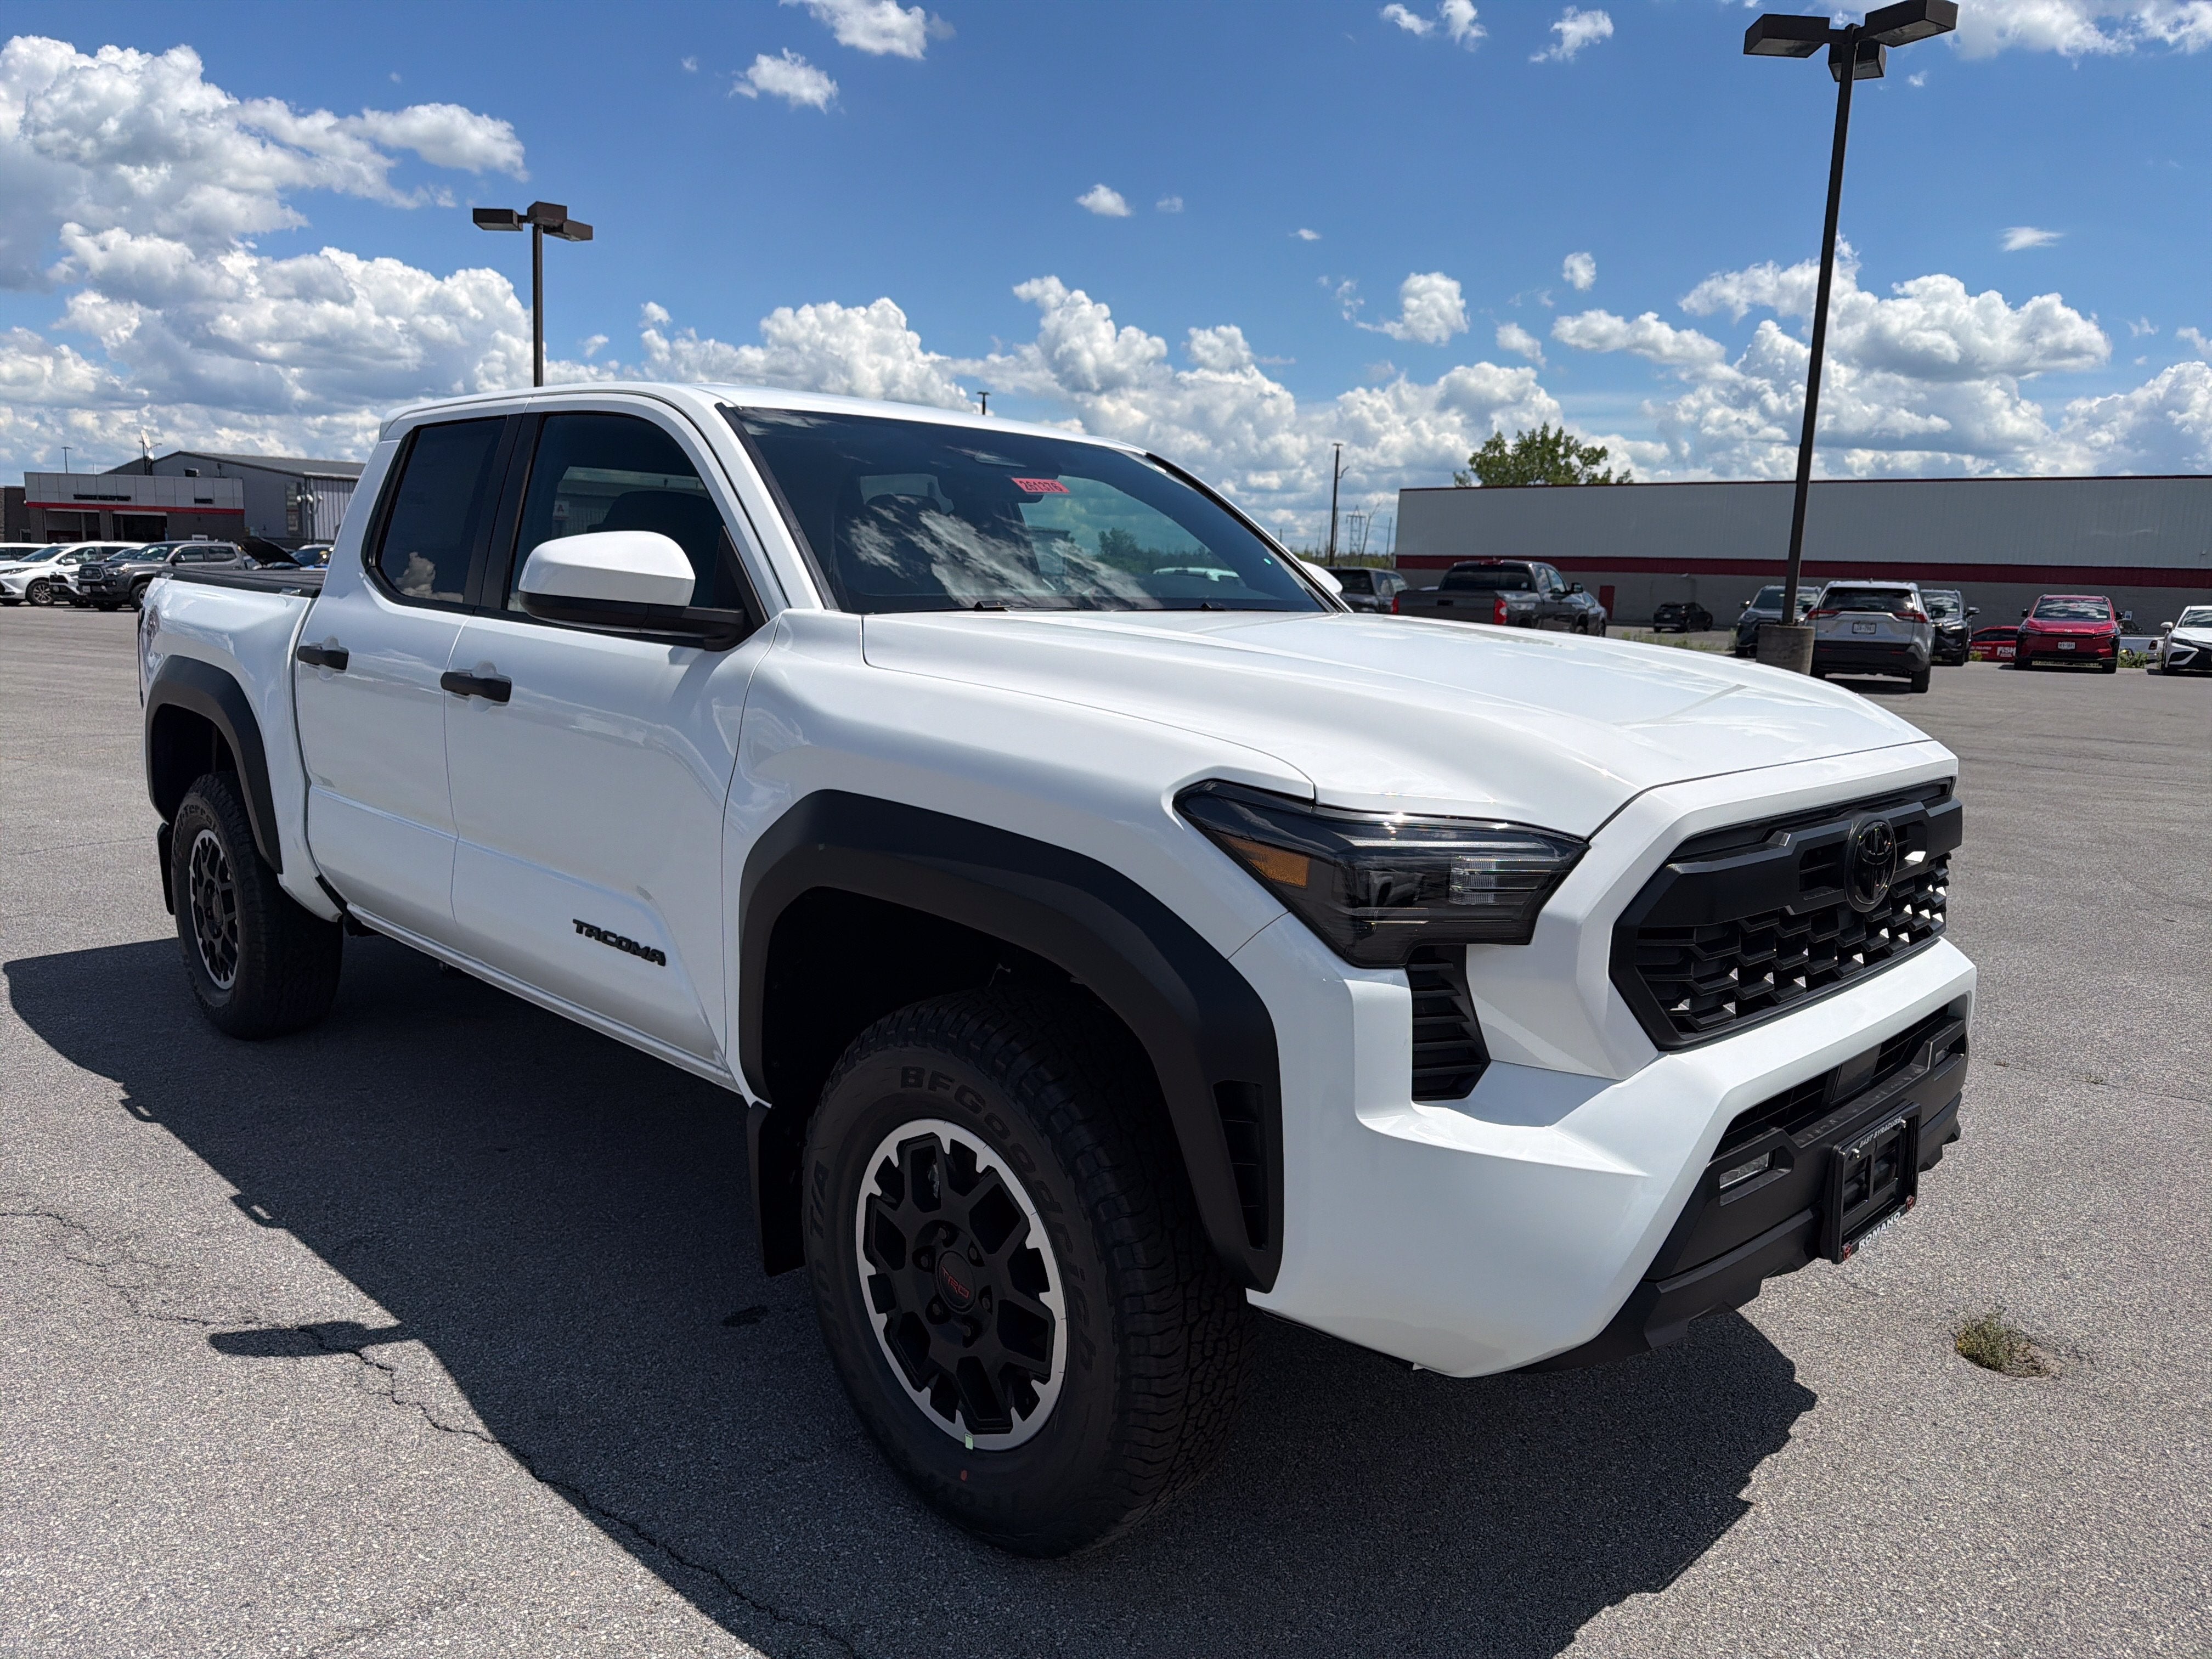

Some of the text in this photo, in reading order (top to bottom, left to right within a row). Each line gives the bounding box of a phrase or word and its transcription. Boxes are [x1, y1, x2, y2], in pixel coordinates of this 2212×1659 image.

[1997, 646, 2016, 656] FISH
[573, 918, 666, 967] TACOMA
[1859, 1116, 1902, 1148] EAST SYRACUSE
[901, 1066, 1097, 1372] BFGoodrich
[1859, 1212, 1900, 1250] ROMANO
[941, 1265, 970, 1299] TRD
